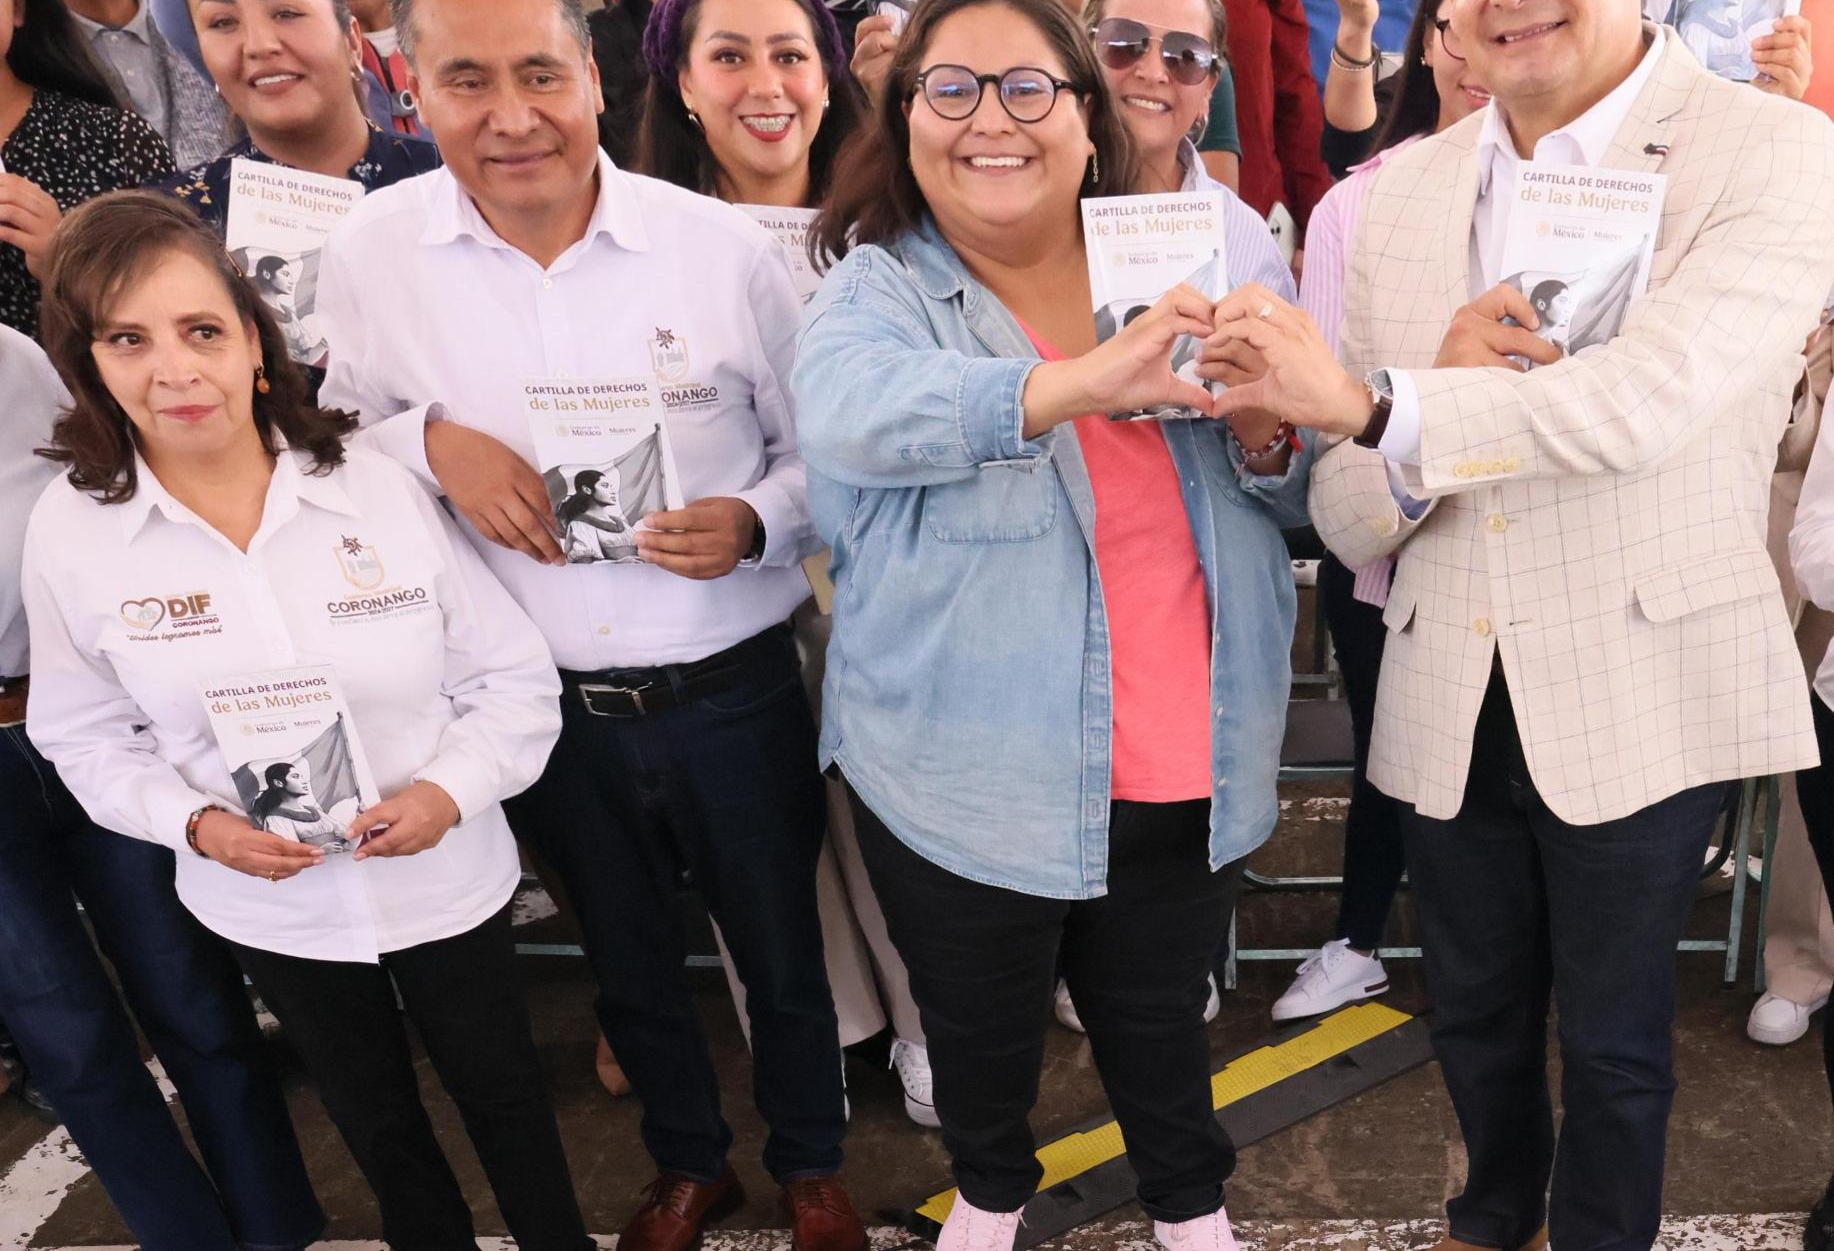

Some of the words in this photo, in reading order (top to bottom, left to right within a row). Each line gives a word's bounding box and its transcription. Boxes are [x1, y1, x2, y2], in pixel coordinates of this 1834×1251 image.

[237, 171, 285, 187] CARTILLA
[287, 181, 299, 190] DE
[302, 184, 353, 201] DERECHOS
[1523, 172, 1576, 186] CARTILLA
[1578, 177, 1593, 187] DE
[1595, 179, 1653, 193] DERECHOS
[236, 183, 256, 197] de
[261, 186, 283, 202] las
[288, 192, 351, 216] Mujeres
[1520, 186, 1542, 202] de
[1548, 188, 1573, 205] las
[1578, 191, 1649, 213] Mujeres
[1089, 206, 1138, 218] CARTILLA
[1140, 204, 1154, 214] DE
[1157, 202, 1212, 213] DERECHOS
[1091, 222, 1110, 236] de
[1116, 220, 1139, 235] las
[1144, 218, 1213, 236] Mujeres
[1552, 228, 1585, 239] México
[1128, 255, 1158, 265] México
[525, 386, 574, 395] CARTILLA
[577, 385, 590, 395] DE
[593, 383, 648, 394] DERECHOS
[661, 386, 718, 403] ONANGO
[529, 398, 550, 411] de
[555, 398, 578, 411] las
[584, 396, 650, 412] Mujeres
[572, 428, 602, 437] México
[167, 593, 211, 618] DIF
[327, 587, 426, 614] CORONANGO
[172, 617, 220, 628] CORONANGO
[205, 686, 254, 699] CARTILLA
[257, 684, 271, 693] DE
[273, 677, 327, 692] DERECHOS
[211, 700, 232, 714] de
[236, 697, 260, 711] las
[264, 690, 333, 710] Mujeres
[256, 724, 287, 734] México
